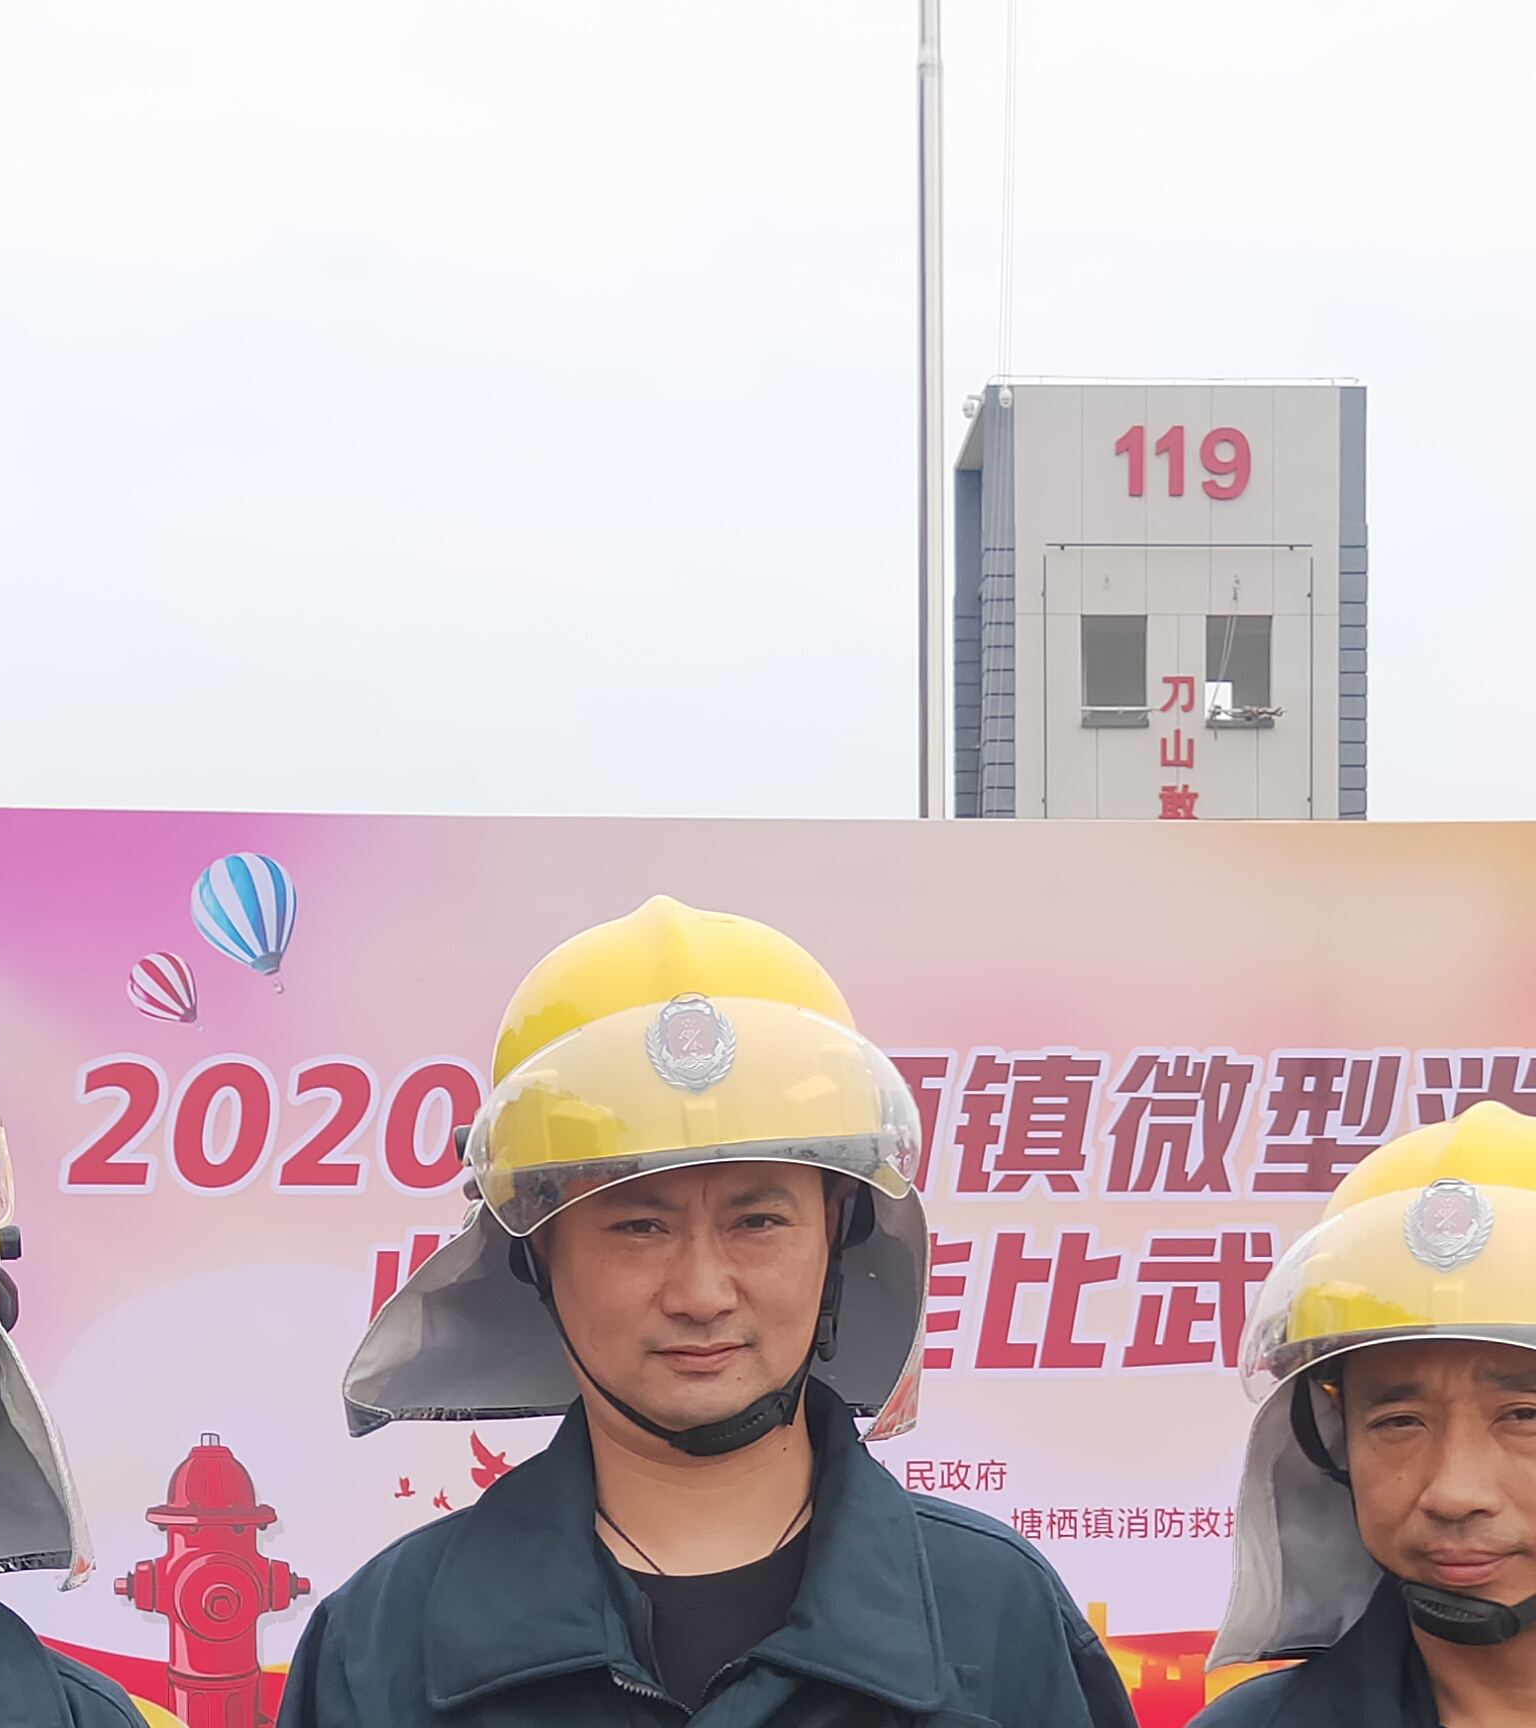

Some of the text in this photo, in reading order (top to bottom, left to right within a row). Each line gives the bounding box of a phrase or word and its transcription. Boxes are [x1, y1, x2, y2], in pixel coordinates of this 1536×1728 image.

[1115, 425, 1252, 500] 119
[1159, 675, 1199, 820] 刀山敢
[880, 1459, 1008, 1492] 民政府
